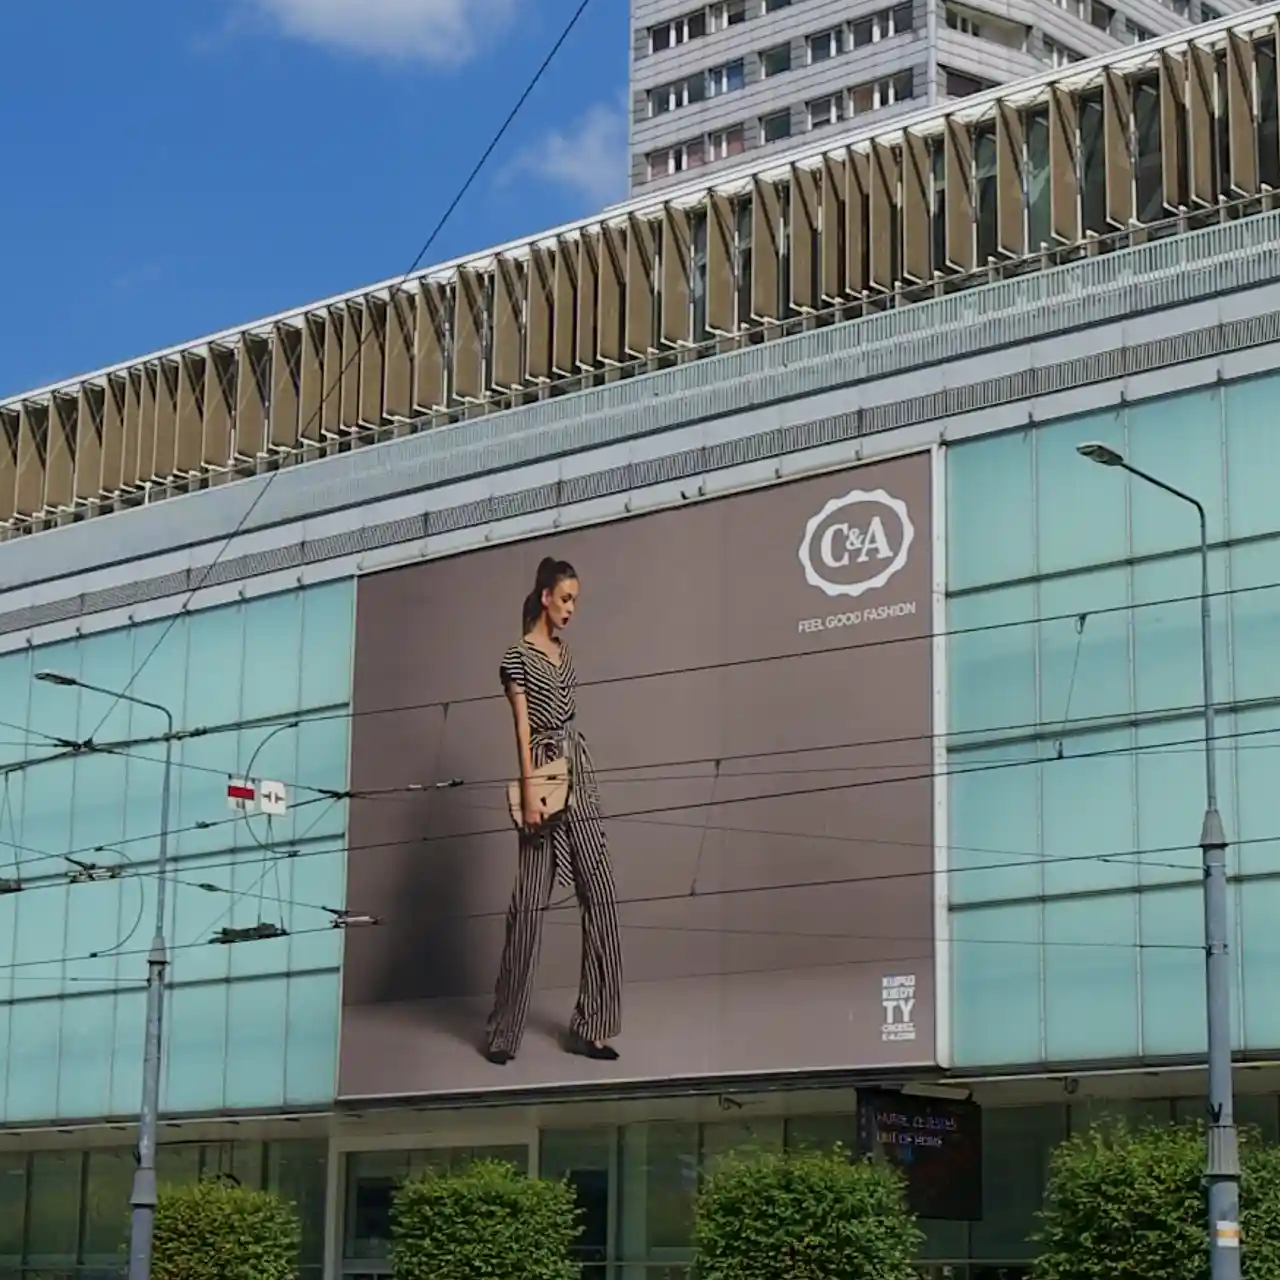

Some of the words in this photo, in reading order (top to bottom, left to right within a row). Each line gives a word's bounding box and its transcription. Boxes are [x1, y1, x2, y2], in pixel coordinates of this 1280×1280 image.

[821, 516, 893, 568] C&A
[798, 618, 825, 634] FEEL
[826, 611, 862, 629] GOOD
[863, 601, 916, 621] FASHION
[882, 999, 916, 1024] TY
